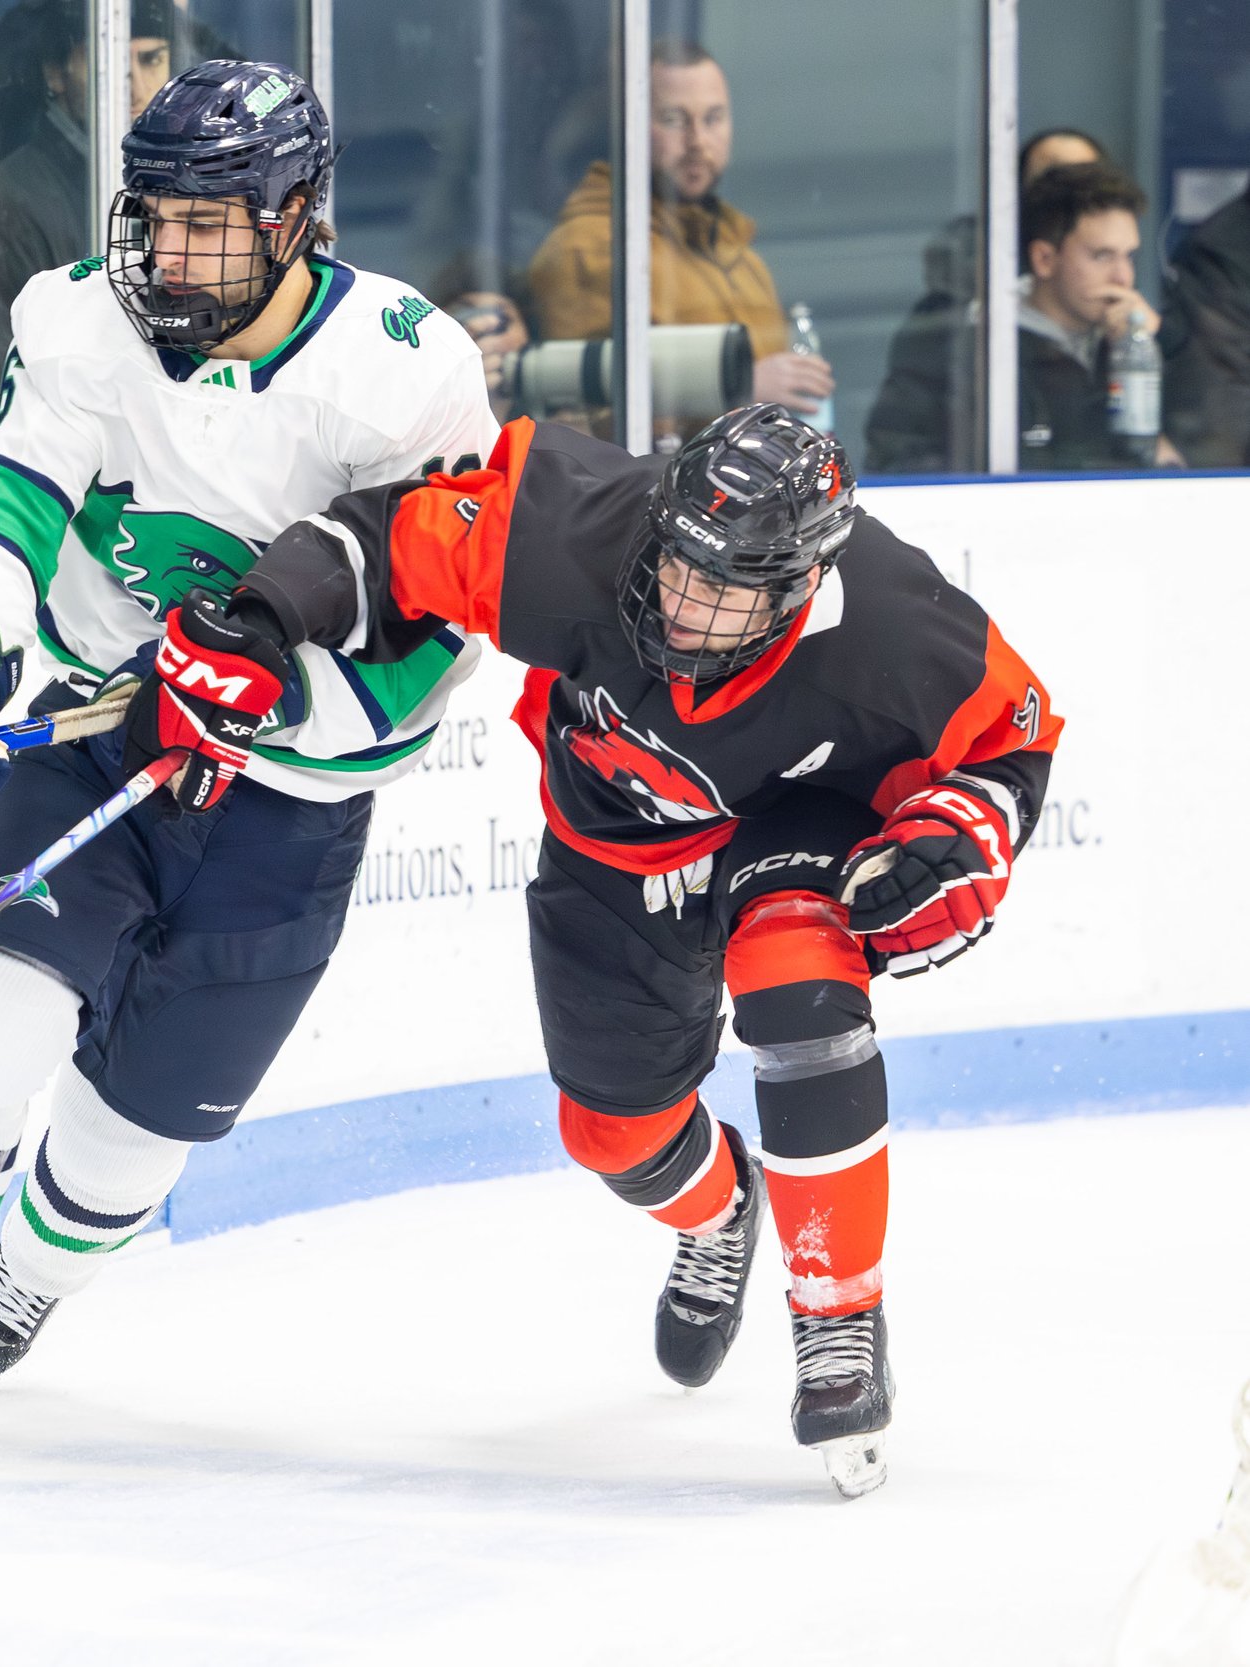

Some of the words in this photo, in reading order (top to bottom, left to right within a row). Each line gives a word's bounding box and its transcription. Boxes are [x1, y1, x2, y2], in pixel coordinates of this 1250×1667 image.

[132, 157, 176, 170] BAUER
[707, 489, 728, 513] 7
[675, 515, 727, 551] CCM
[157, 636, 253, 704] CM
[779, 741, 835, 778] A
[192, 768, 214, 807] CCM
[1029, 799, 1103, 848] nc.
[729, 852, 834, 894] CCM
